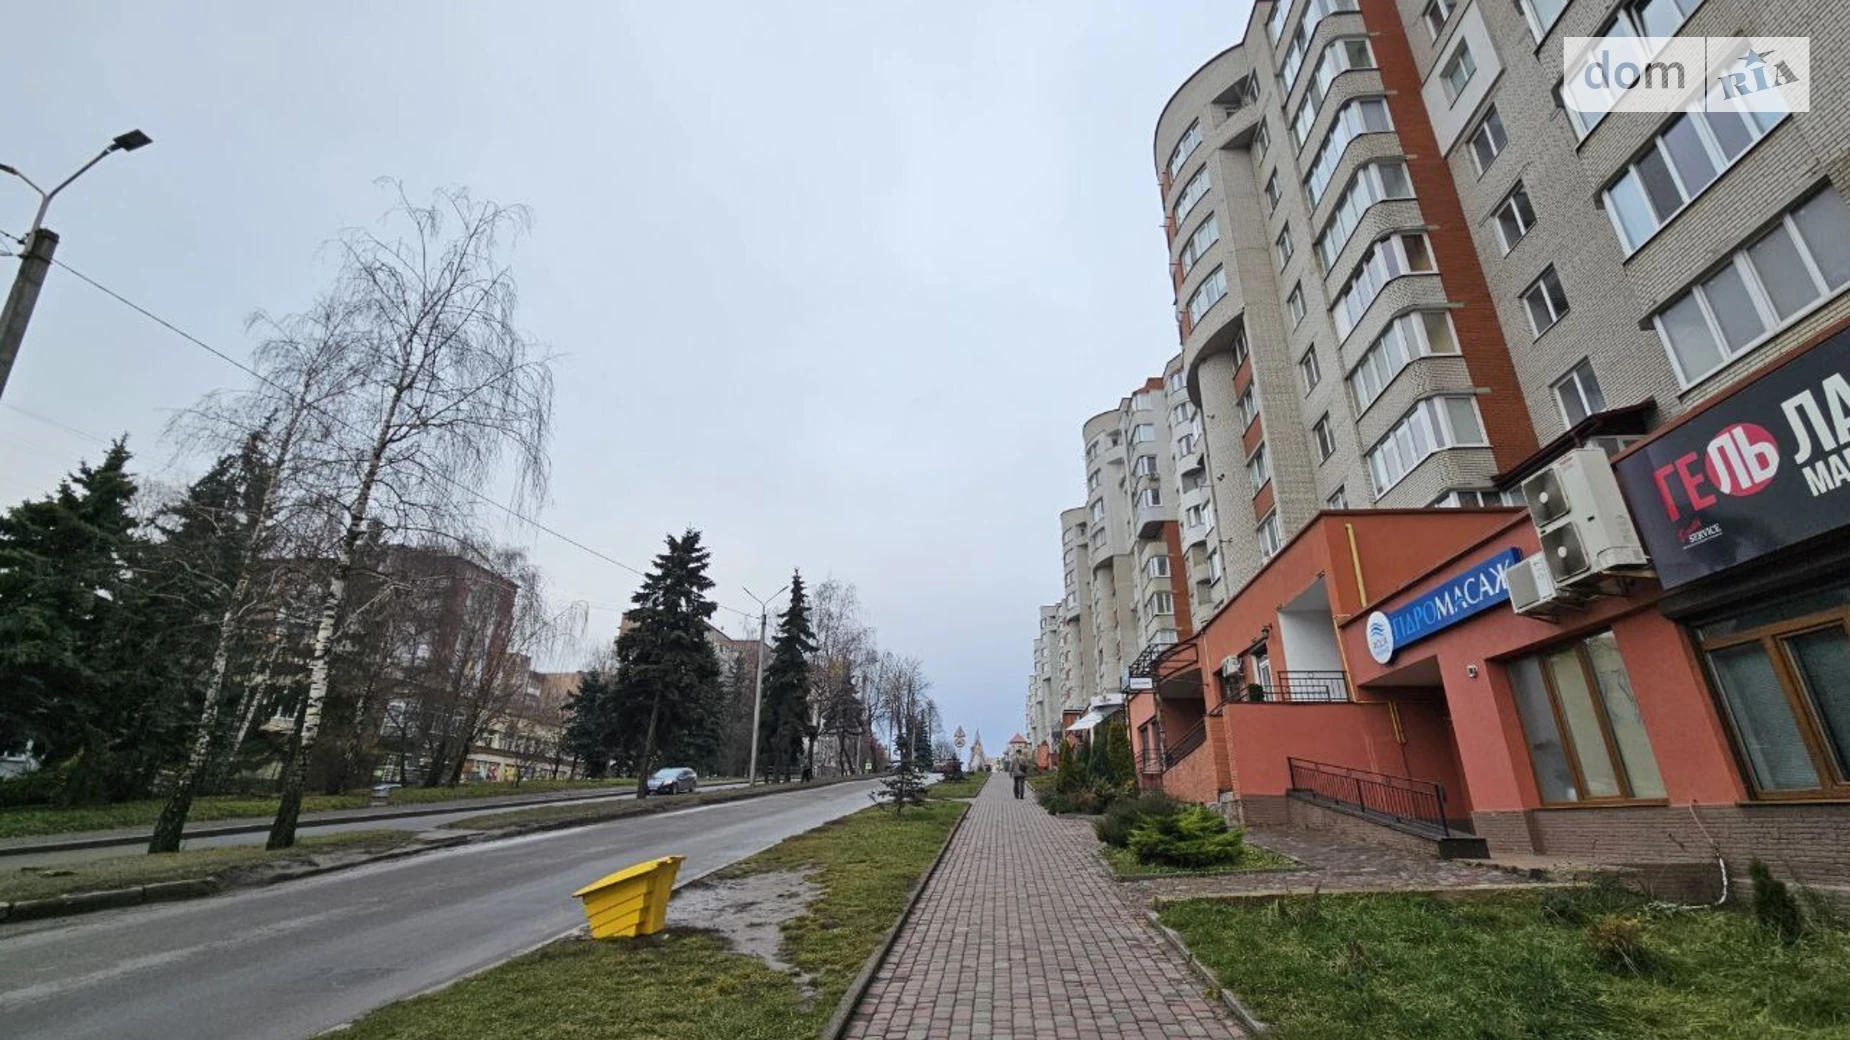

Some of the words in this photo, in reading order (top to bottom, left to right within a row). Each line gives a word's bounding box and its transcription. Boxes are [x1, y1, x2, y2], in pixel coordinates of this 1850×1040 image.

[1653, 426, 1780, 522] ГЕЛЬ
[1689, 522, 1723, 543] SERVICE
[1392, 559, 1510, 640] ГІДРОМАСАЖ
